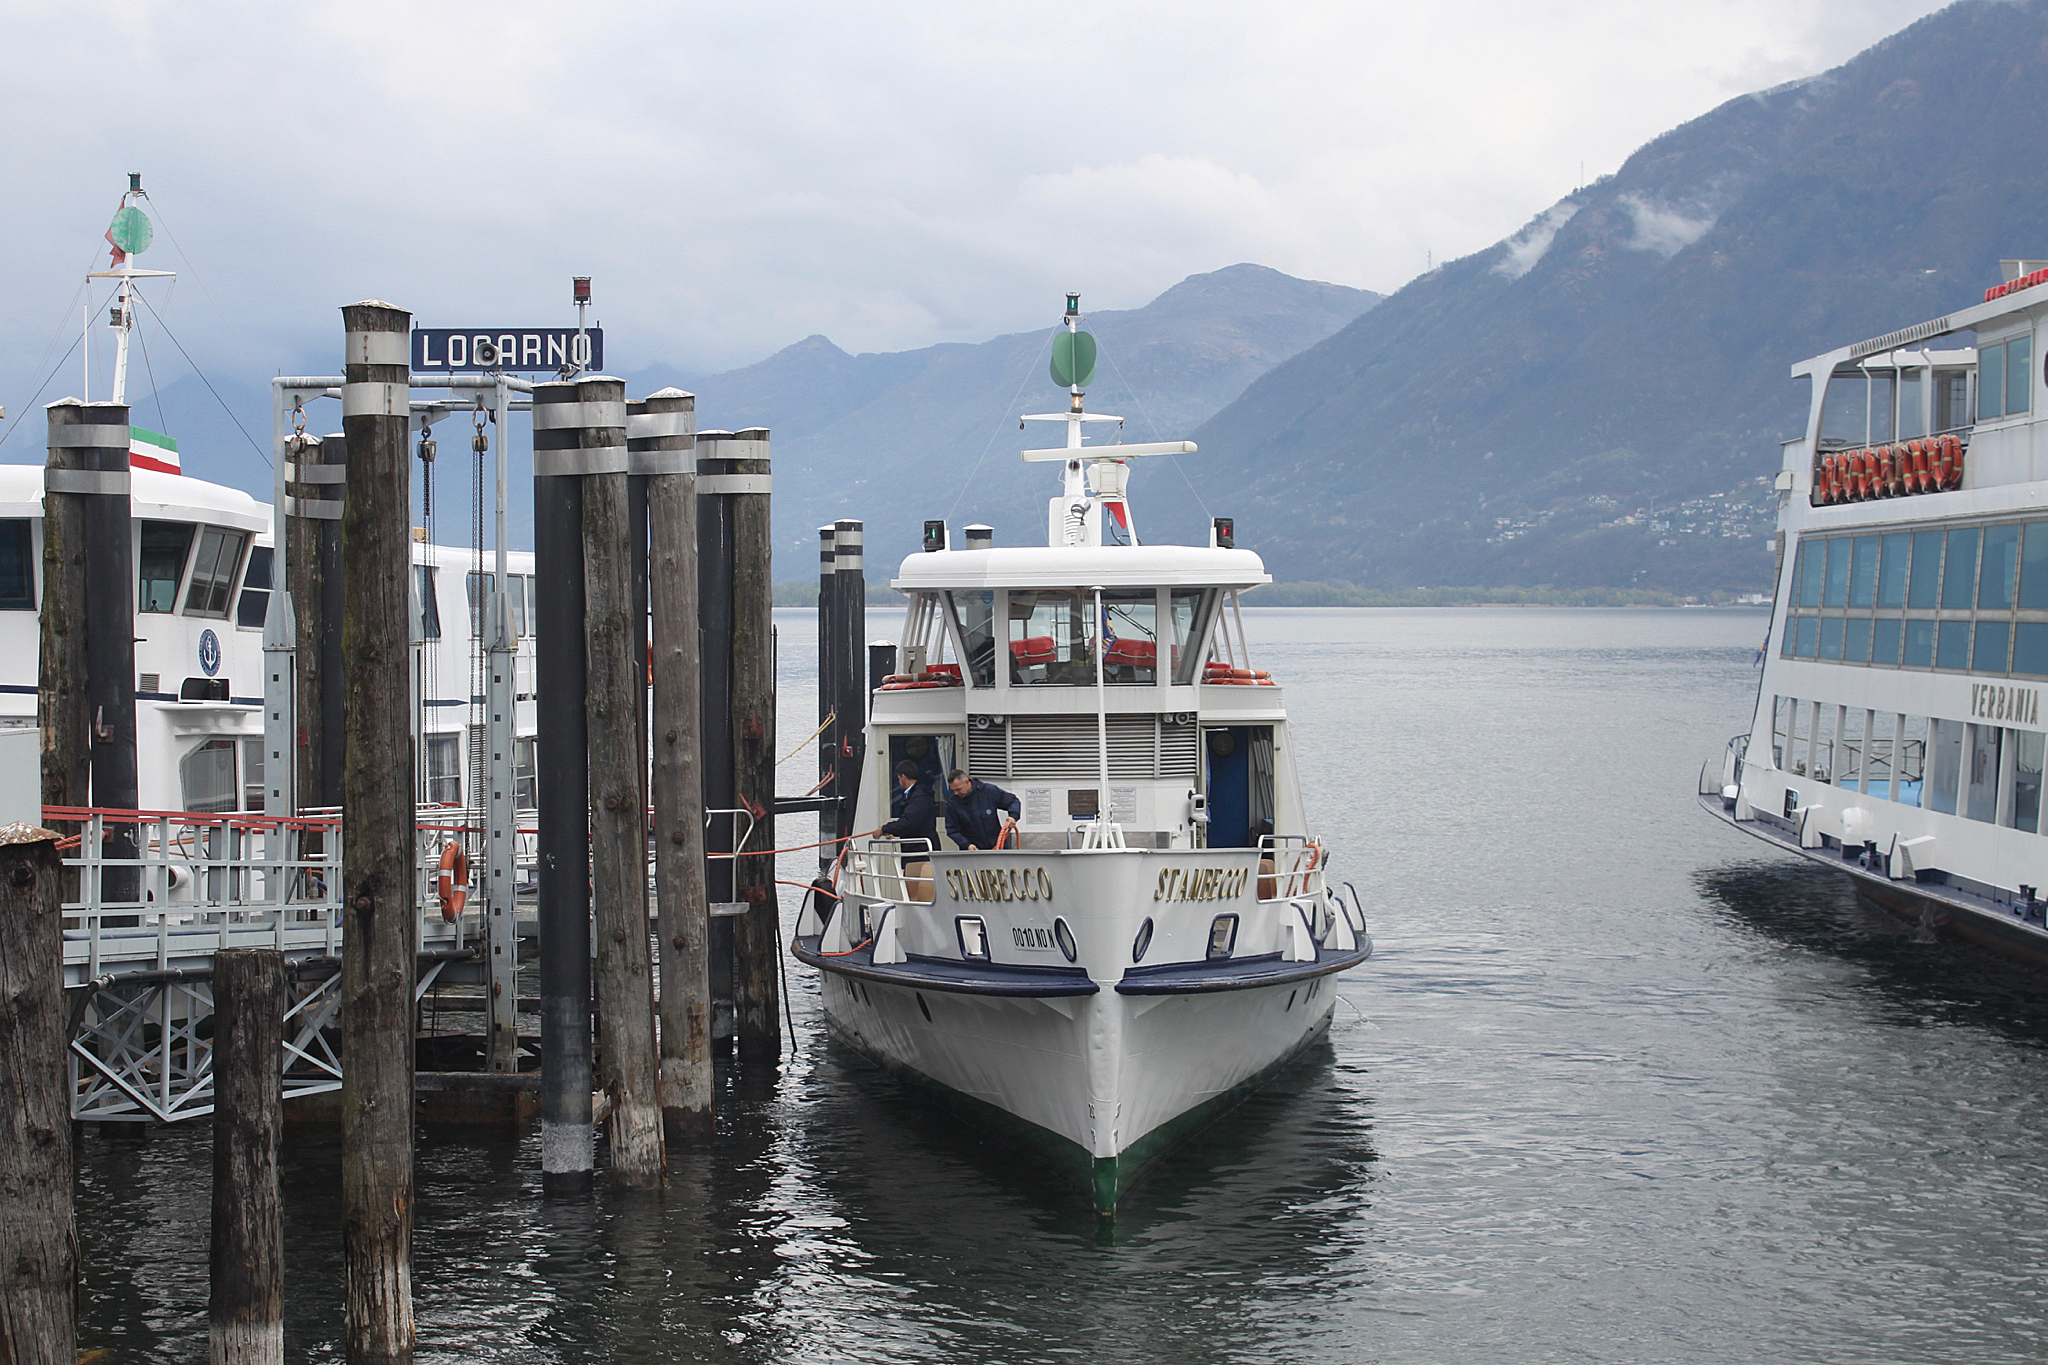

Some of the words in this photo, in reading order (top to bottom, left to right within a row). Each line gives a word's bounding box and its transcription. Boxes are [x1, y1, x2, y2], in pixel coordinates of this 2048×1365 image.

[1971, 683, 2038, 725] VERBANIA
[946, 866, 1052, 901] STAMBECCO
[1154, 867, 1248, 902] STAMBECCO
